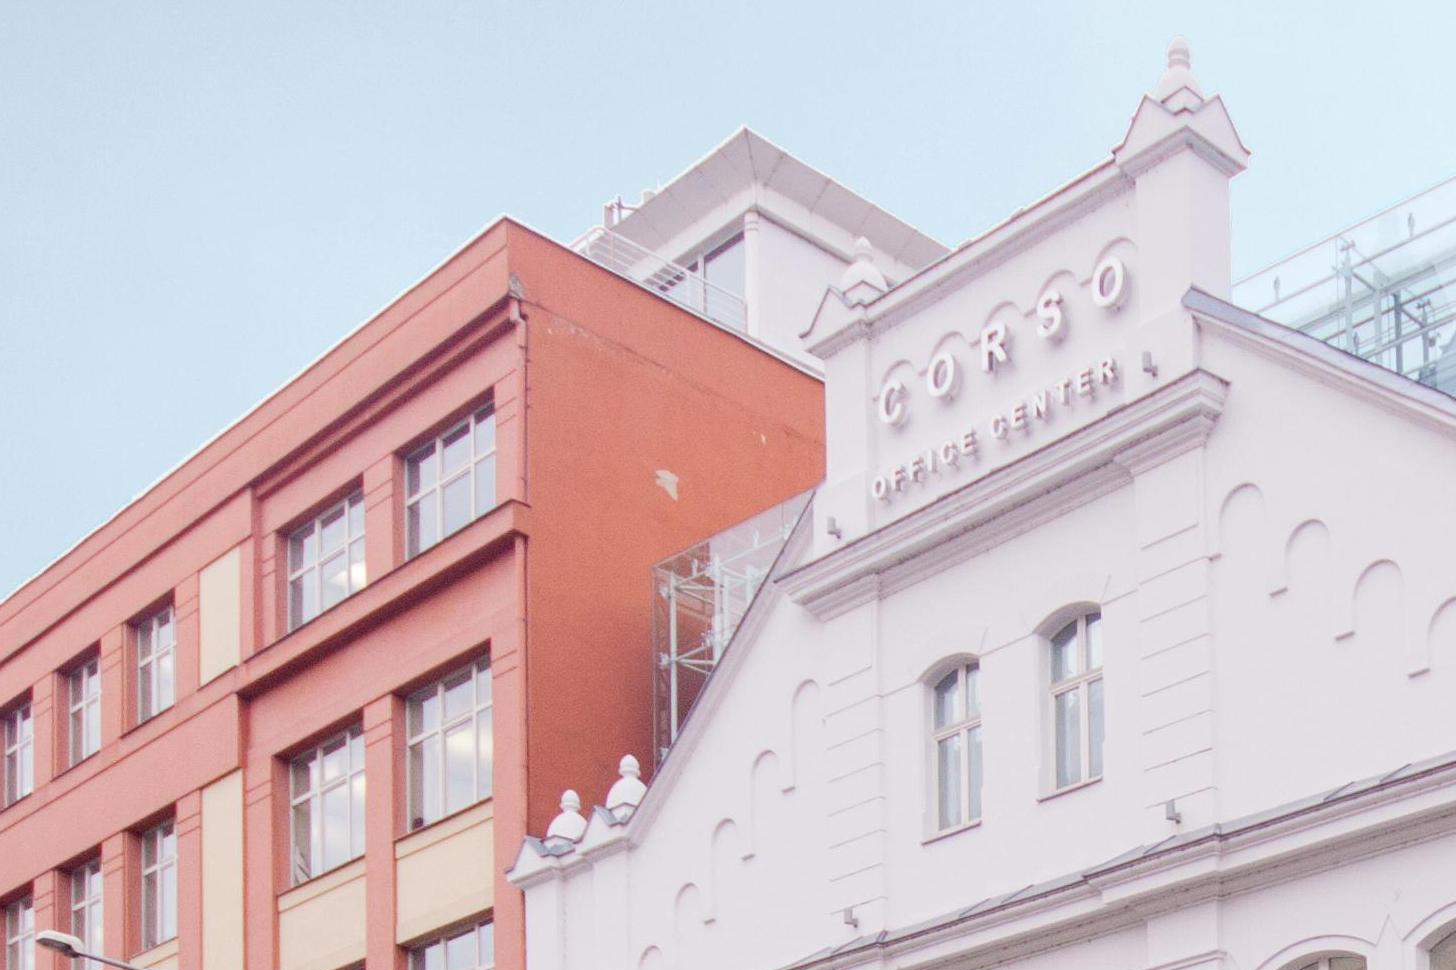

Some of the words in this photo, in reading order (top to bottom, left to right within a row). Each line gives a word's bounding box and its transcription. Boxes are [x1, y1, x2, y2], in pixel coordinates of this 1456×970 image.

[878, 256, 1128, 428] CORSO
[871, 427, 980, 503] OFFICE
[989, 357, 1121, 443] CENTER
